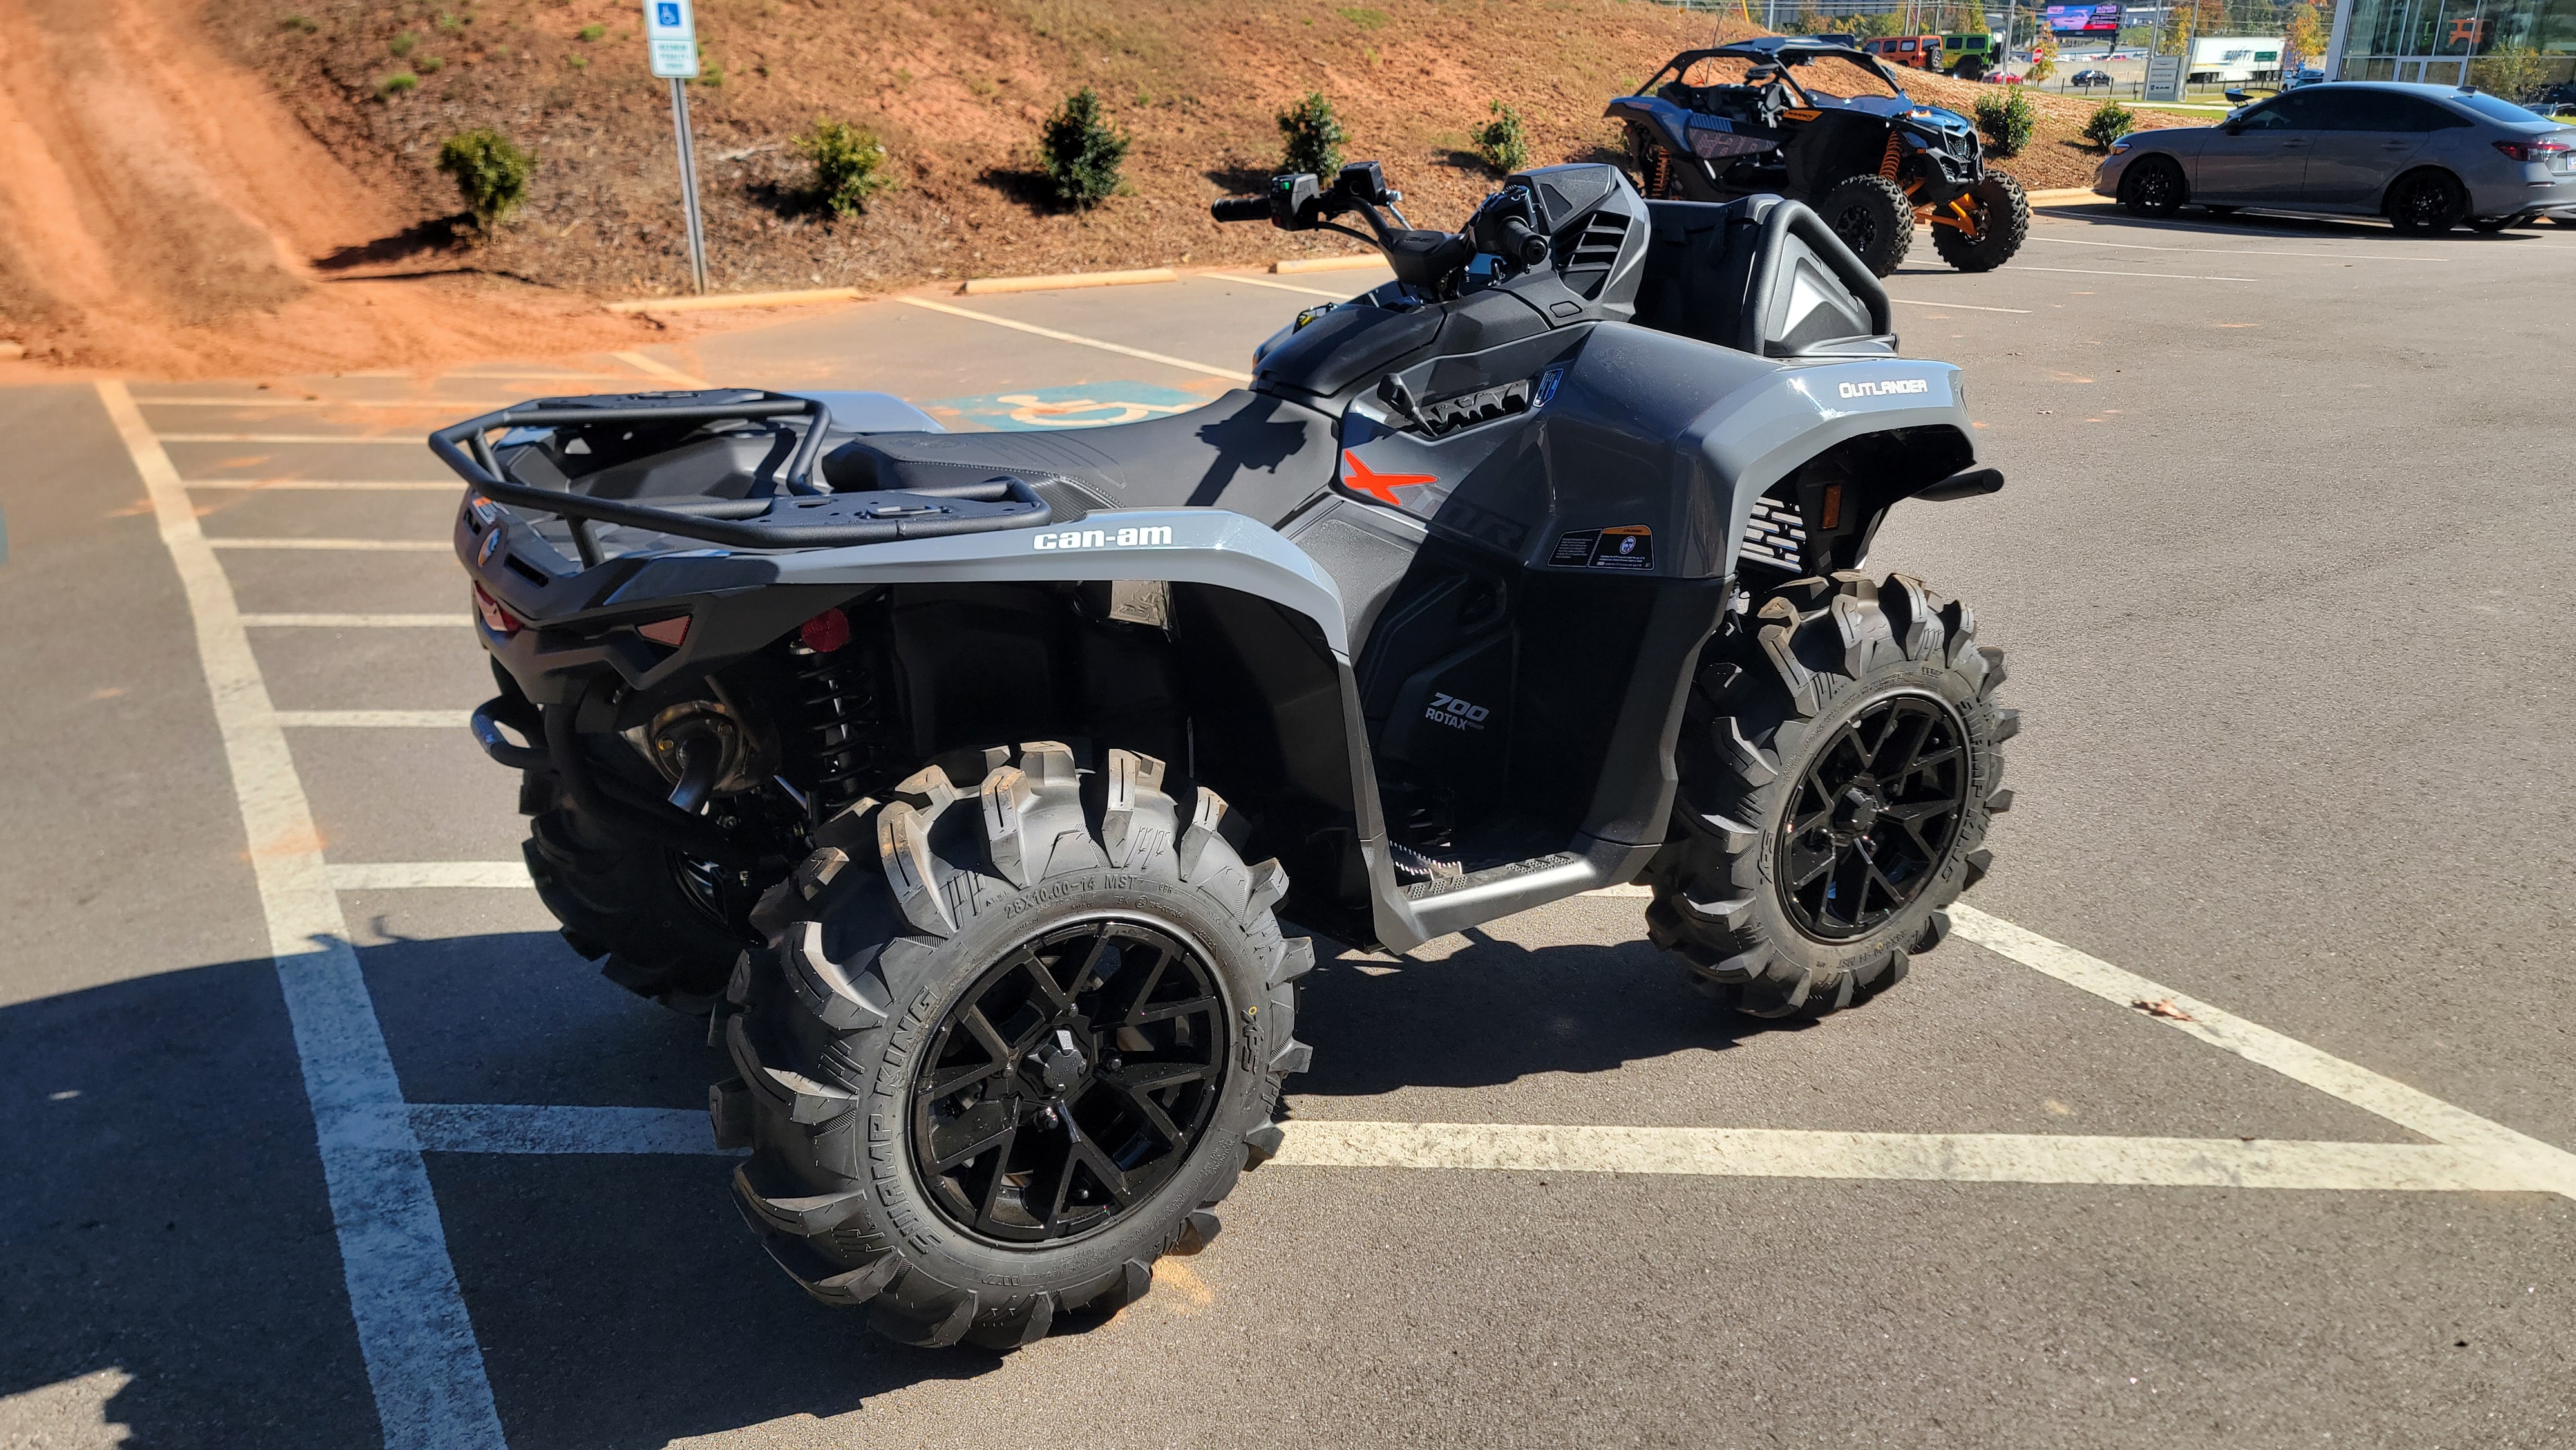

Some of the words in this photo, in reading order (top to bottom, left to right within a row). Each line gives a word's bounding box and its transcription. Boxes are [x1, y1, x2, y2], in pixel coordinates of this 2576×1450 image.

[1839, 379, 1927, 399] OUTLANDER
[1034, 525, 1172, 550] can-am
[1425, 708, 1466, 730] ROTAX
[1430, 692, 1489, 722] 700
[1004, 875, 1095, 919] 28X10.00-14
[1104, 873, 1138, 890] MST
[878, 985, 940, 1099] KING
[867, 1114, 943, 1257] SWAMP
